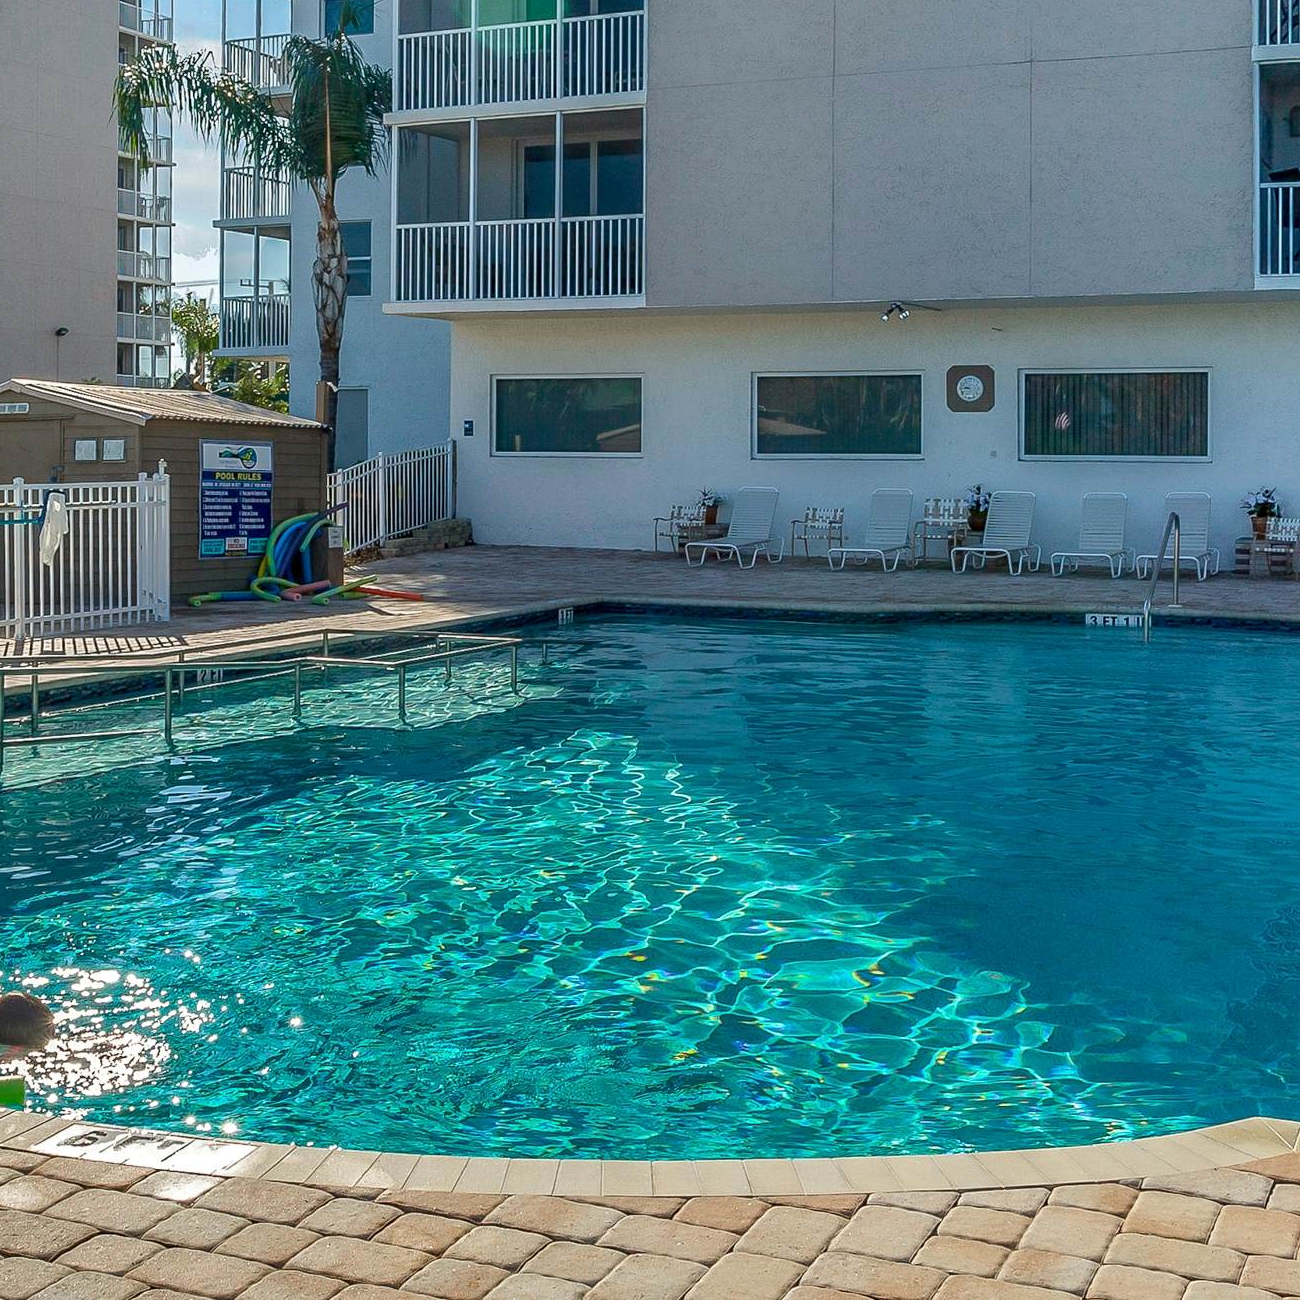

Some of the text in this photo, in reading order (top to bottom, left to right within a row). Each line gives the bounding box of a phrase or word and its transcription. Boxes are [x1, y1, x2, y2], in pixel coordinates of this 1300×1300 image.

[215, 472, 262, 481] POOL RULES
[1090, 615, 1098, 626] 3
[1103, 616, 1117, 626] FT
